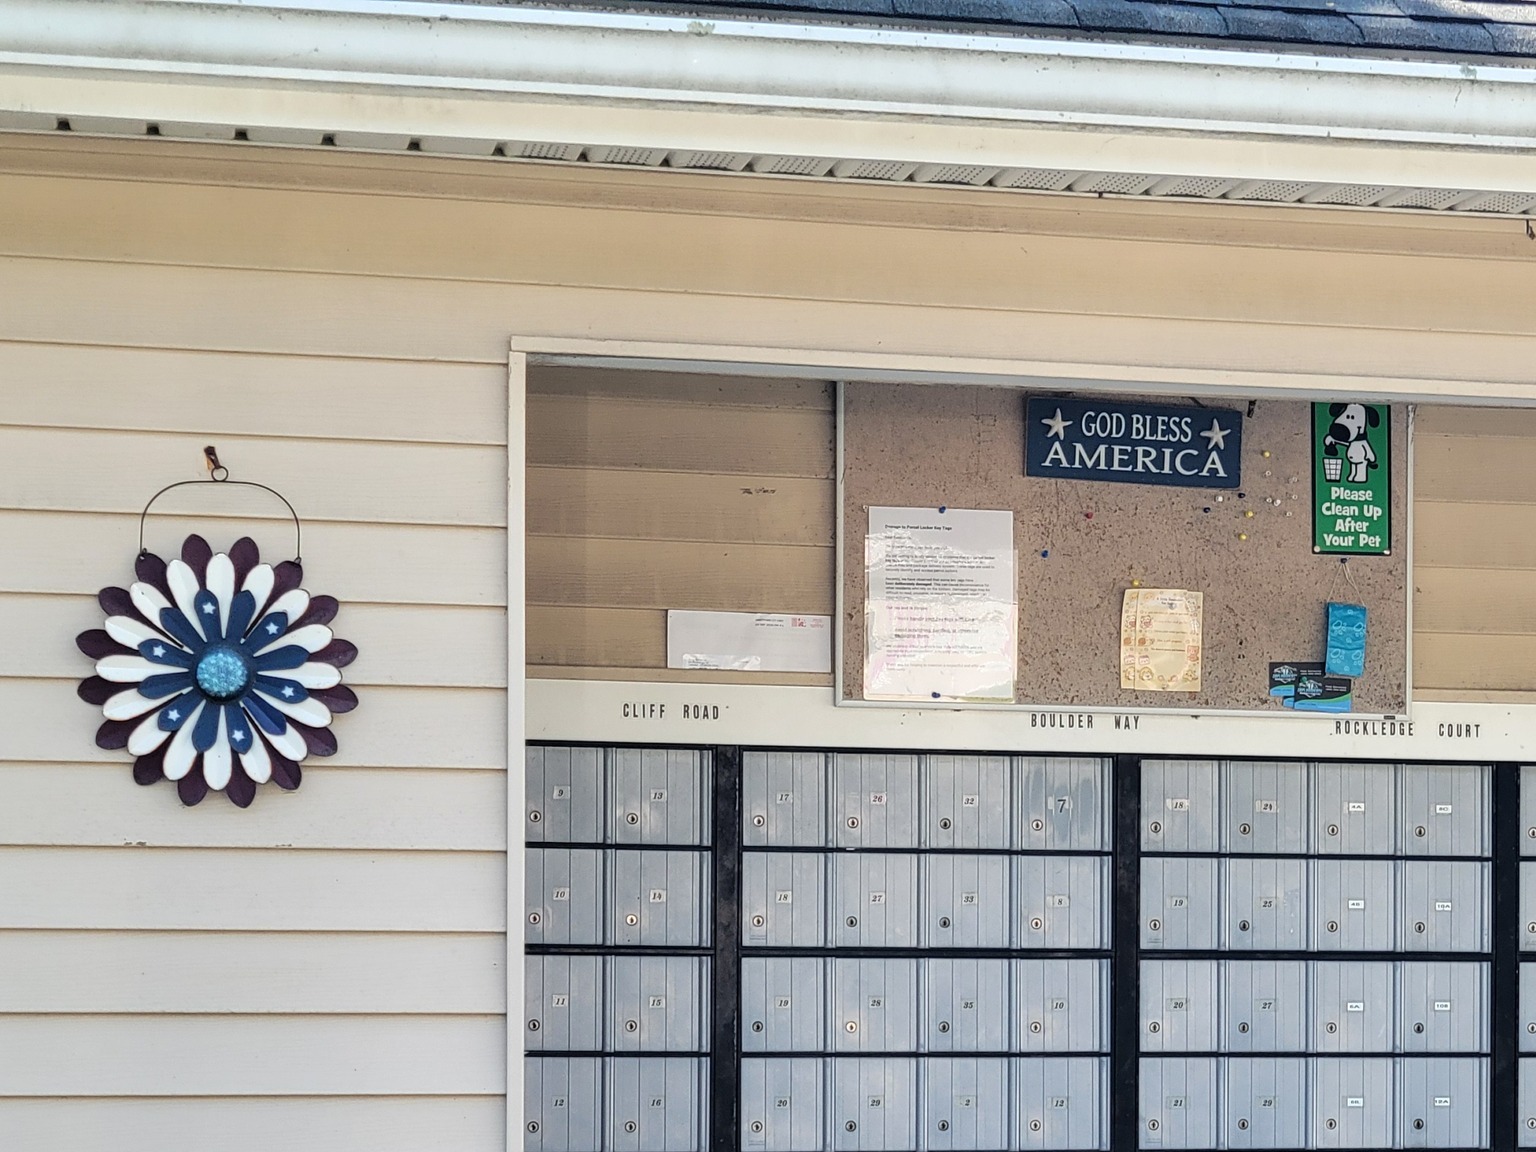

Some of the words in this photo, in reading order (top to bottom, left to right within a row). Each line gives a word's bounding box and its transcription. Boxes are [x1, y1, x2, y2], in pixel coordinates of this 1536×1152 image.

[1081, 411, 1125, 438] GOD
[1131, 414, 1192, 443] BLESS
[1041, 441, 1228, 477] AMERICA
[1331, 486, 1373, 501] Please
[1321, 502, 1358, 516] Clean
[1363, 505, 1382, 521] Up
[1335, 517, 1369, 532] After
[1323, 533, 1354, 547] Your
[1359, 535, 1381, 547] Pet
[622, 703, 666, 719] CLIFF
[683, 704, 720, 720] ROAD
[1031, 713, 1094, 729] BOULDER
[1114, 715, 1140, 730] WAY
[1335, 720, 1414, 737] ROCKLEDGE
[1438, 723, 1481, 738] COURT
[557, 789, 564, 797] 9
[652, 792, 664, 800] 13
[778, 793, 790, 802] 17
[872, 795, 883, 803] 26
[964, 797, 975, 805] 32
[1057, 798, 1067, 814] 7
[1173, 801, 1184, 809] 18
[1262, 802, 1273, 811] 24
[554, 890, 566, 899] 10
[651, 892, 663, 901] 14
[777, 893, 789, 902] 18
[871, 894, 883, 902] 27
[963, 895, 975, 903] 33
[1057, 898, 1063, 906] 8
[1173, 899, 1184, 907] 19
[1262, 900, 1273, 908] 25
[555, 997, 566, 1006] 11
[650, 998, 662, 1007] 15
[778, 999, 789, 1007] 19
[870, 999, 882, 1007] 28
[963, 1001, 974, 1009] 35
[1053, 1001, 1065, 1010] 10
[1173, 1001, 1184, 1009] 20
[1261, 1001, 1273, 1010] 27
[553, 1098, 565, 1107] 12
[650, 1098, 662, 1107] 16
[776, 1099, 788, 1107] 20
[870, 1099, 881, 1107] 29
[964, 1099, 971, 1107] 2
[1054, 1099, 1065, 1107] 12
[1173, 1099, 1183, 1107] 21
[1262, 1099, 1273, 1107] 29
